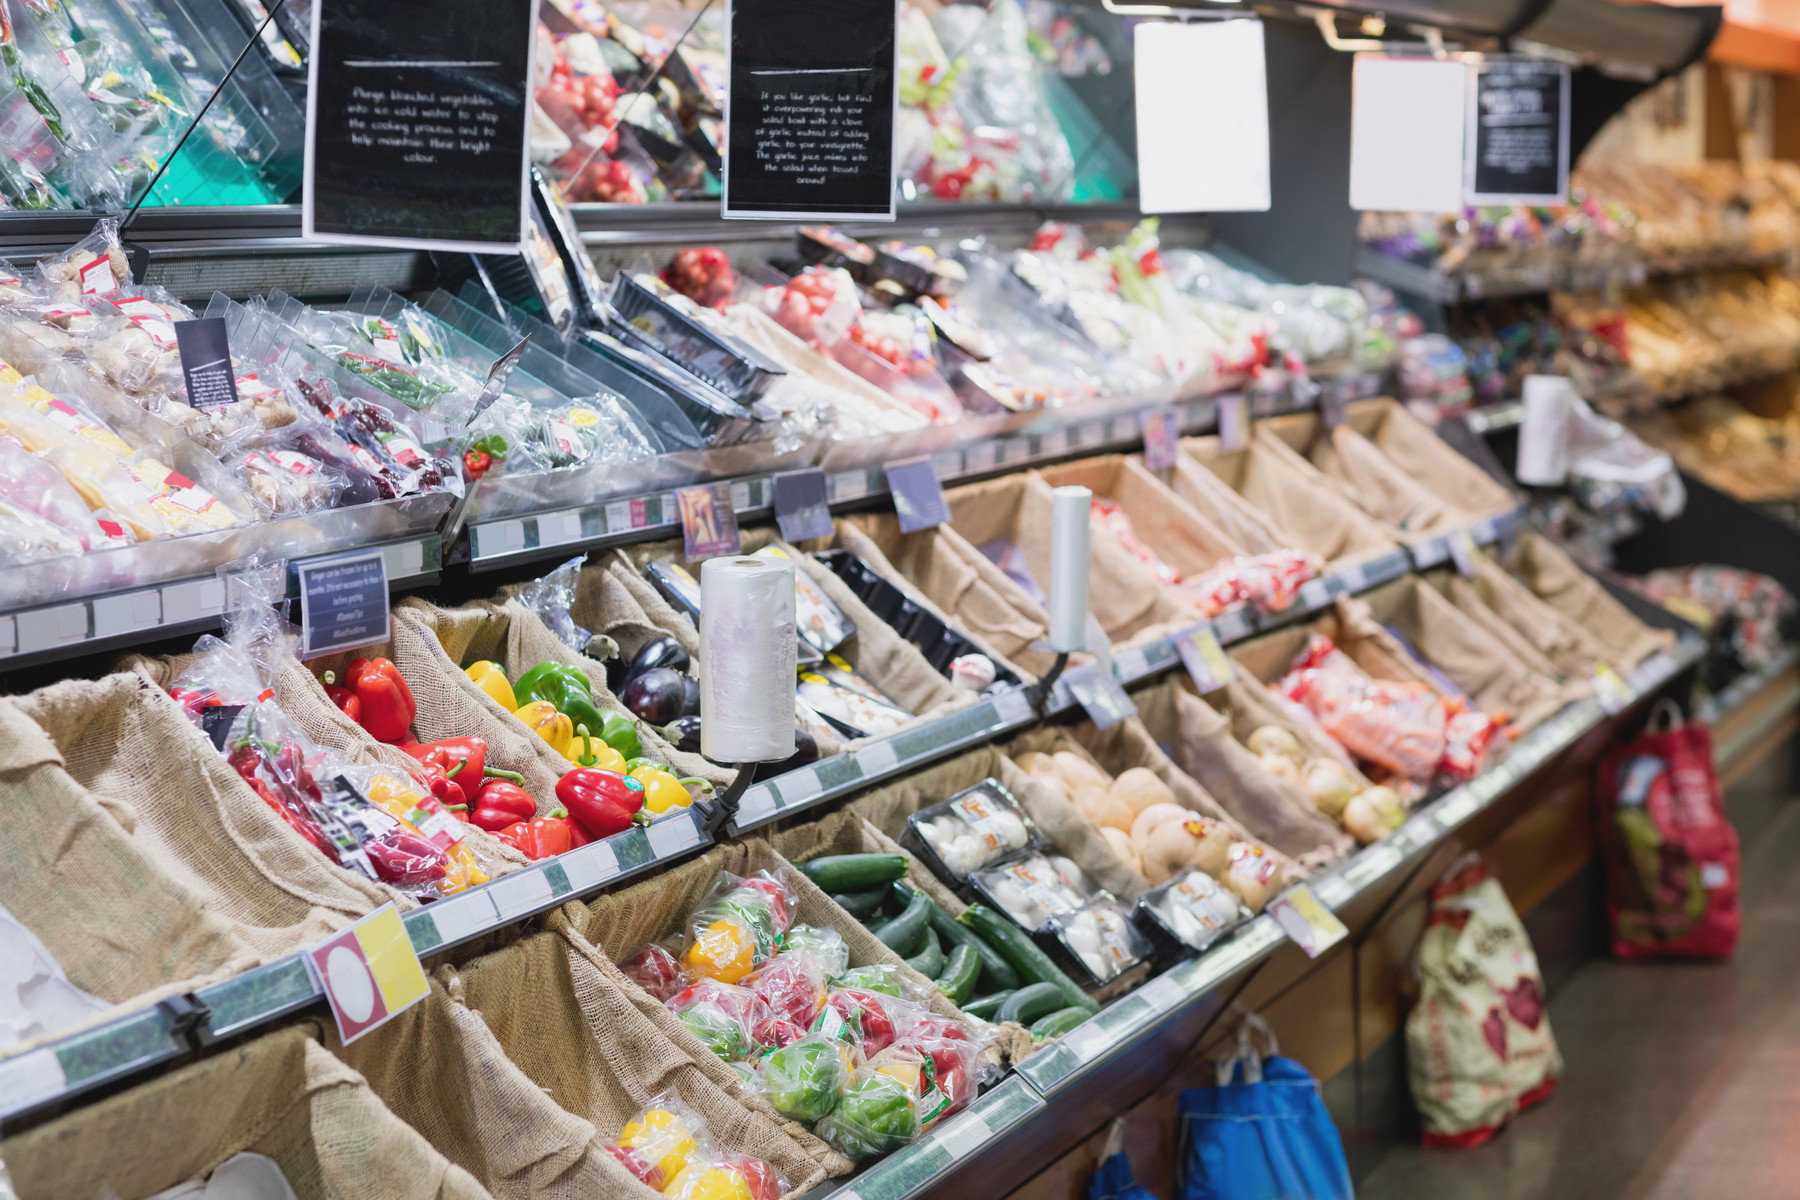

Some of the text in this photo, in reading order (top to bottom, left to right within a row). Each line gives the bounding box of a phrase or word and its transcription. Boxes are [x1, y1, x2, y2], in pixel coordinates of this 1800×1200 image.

[391, 89, 435, 102] blanched
[440, 93, 493, 107] vegetables
[761, 91, 768, 100] If
[808, 94, 833, 103] garlic,
[347, 104, 368, 113] into
[395, 106, 416, 117] cold
[422, 109, 450, 118] water
[459, 110, 470, 119] to
[477, 110, 498, 122] stop
[775, 106, 825, 116] overpowering
[349, 119, 495, 136] the cooking process and to
[769, 130, 791, 139] garlic
[844, 131, 869, 140] adding
[352, 133, 490, 154] help maintain their bright
[758, 141, 780, 149] garlic
[775, 152, 797, 162] garlic
